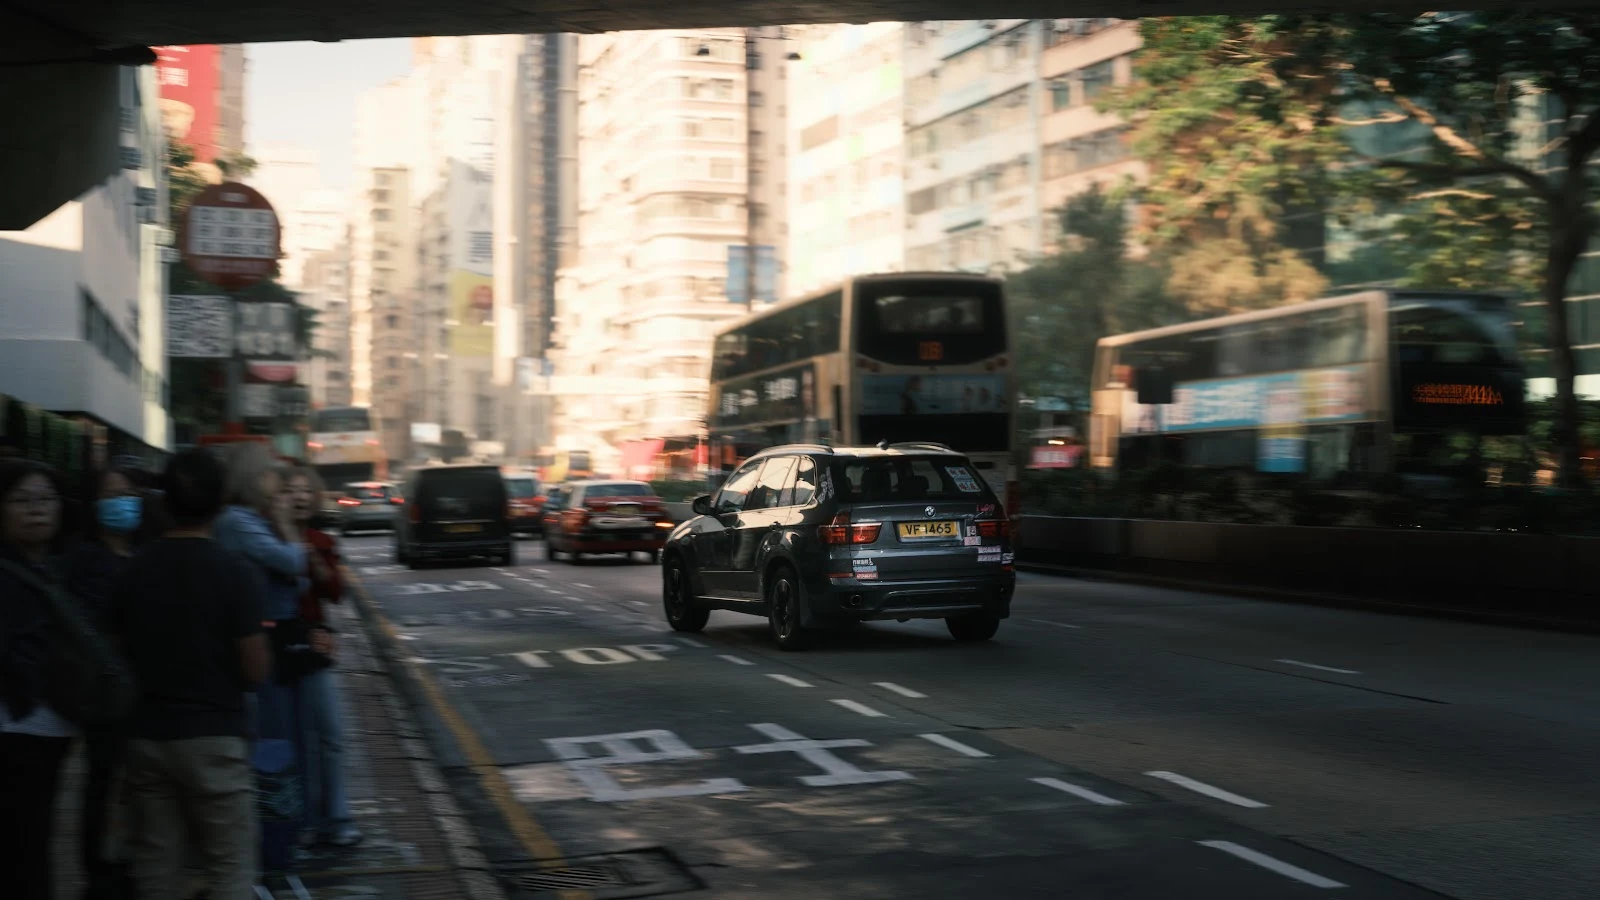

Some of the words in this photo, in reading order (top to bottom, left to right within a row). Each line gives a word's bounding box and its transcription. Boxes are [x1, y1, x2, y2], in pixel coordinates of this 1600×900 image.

[905, 523, 921, 535] VF
[925, 523, 951, 534] 1465
[430, 643, 680, 673] STOP
[541, 723, 917, 801] 巴士
